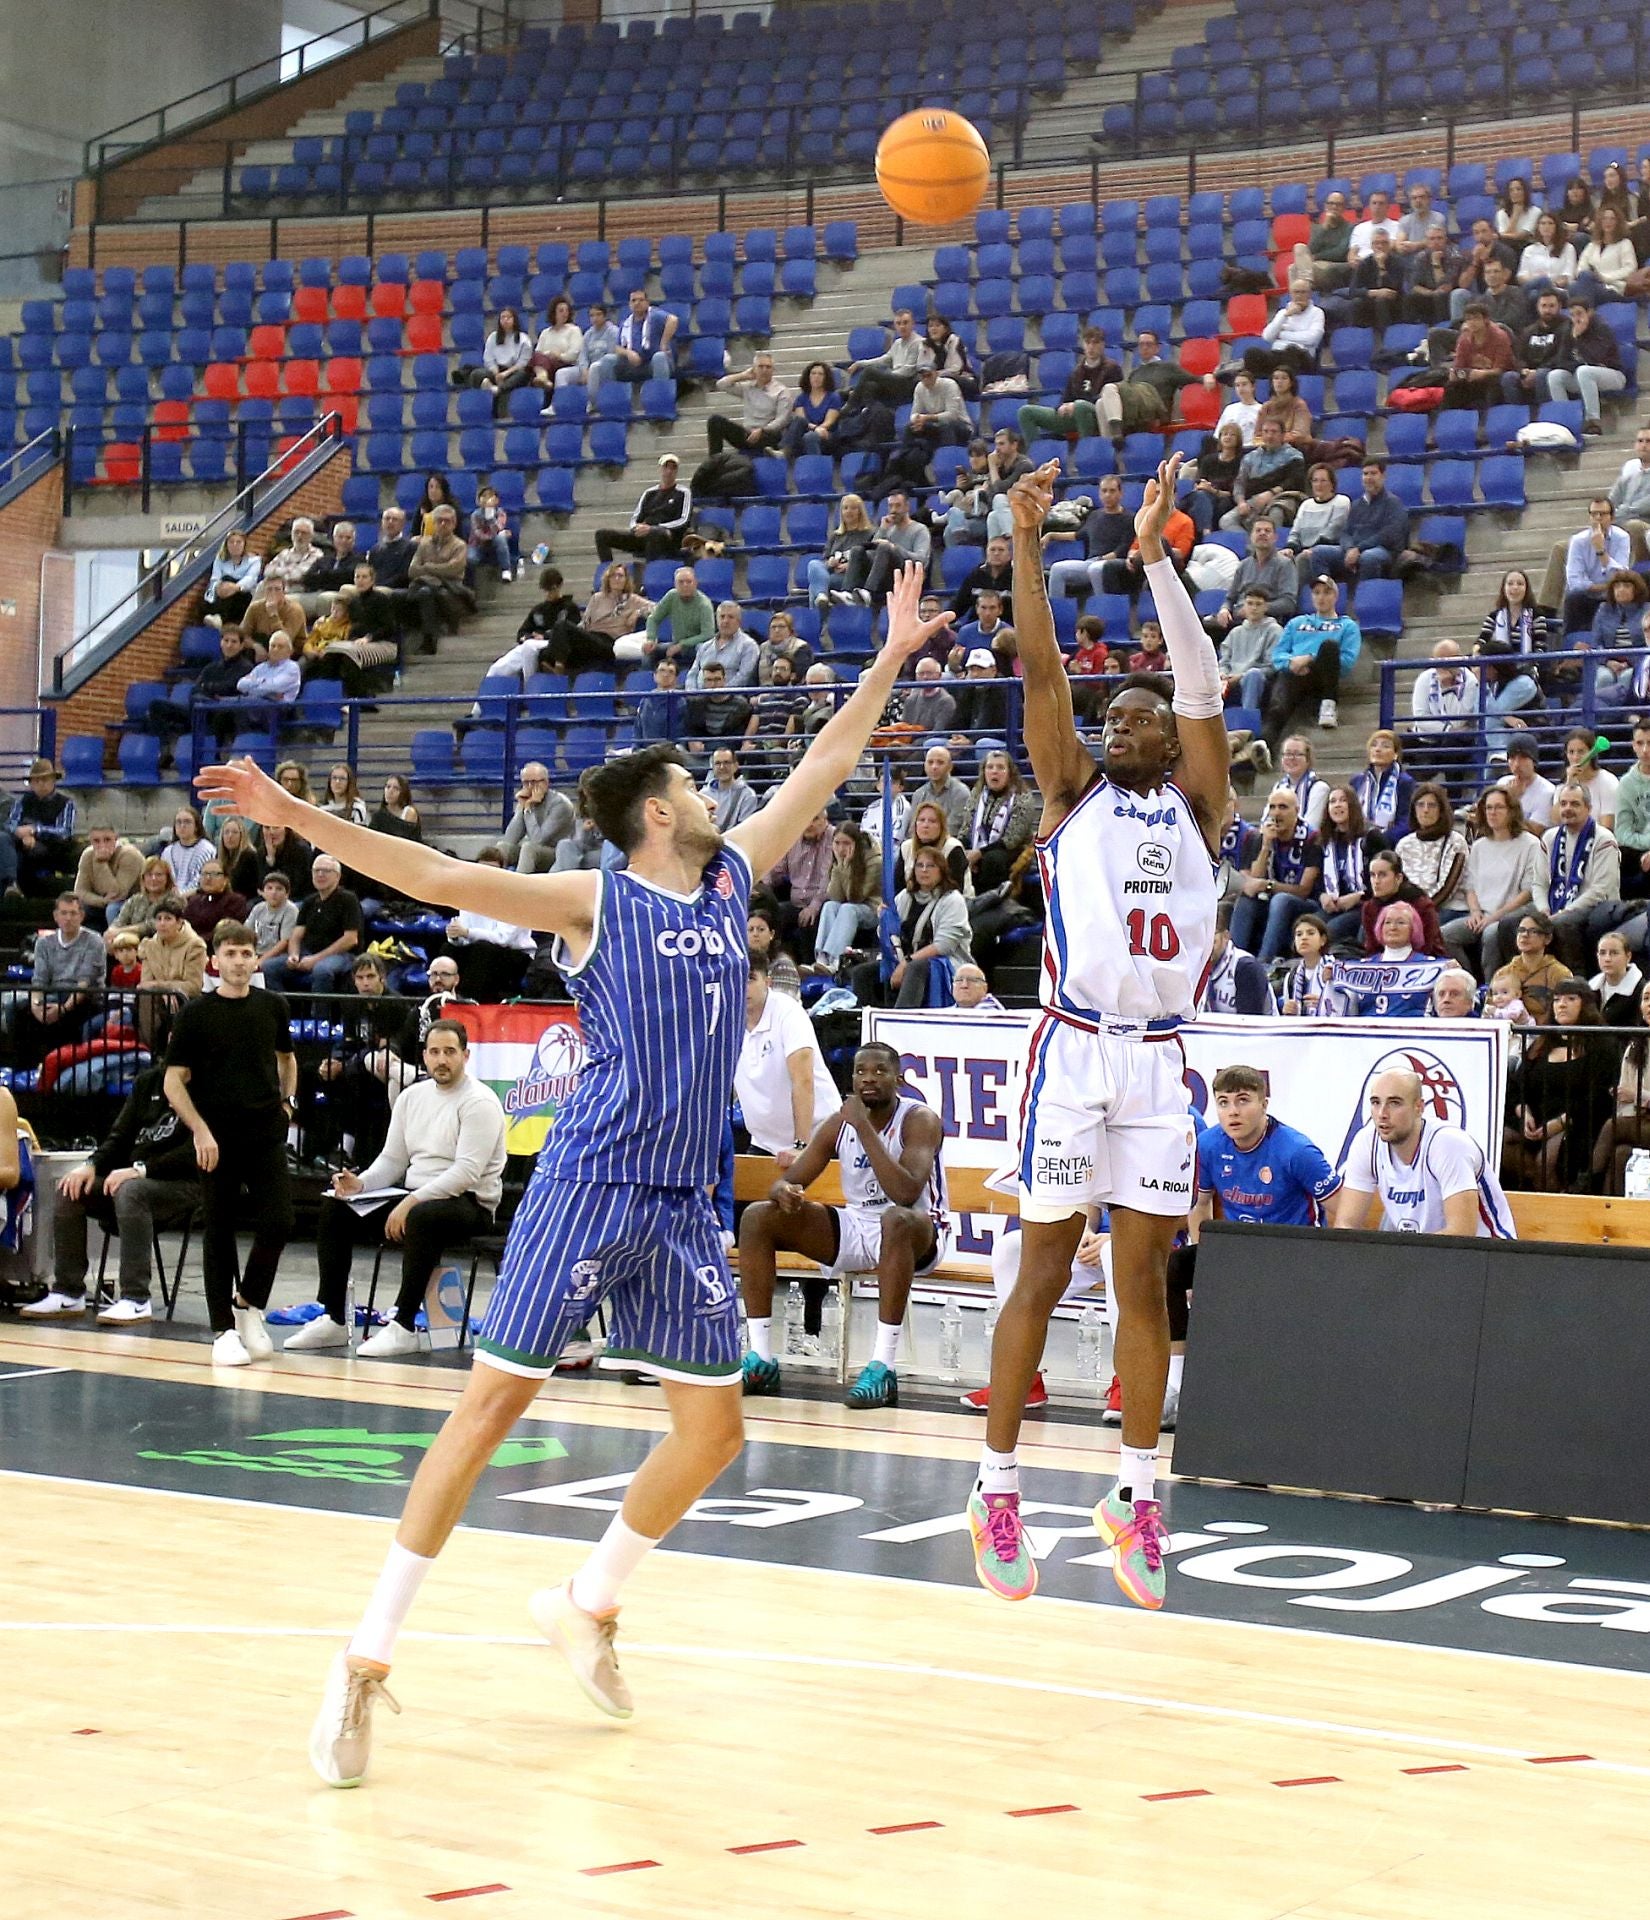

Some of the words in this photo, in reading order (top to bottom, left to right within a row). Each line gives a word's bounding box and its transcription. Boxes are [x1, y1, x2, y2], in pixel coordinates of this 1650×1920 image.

[165, 522, 200, 532] SALIDA
[1127, 908, 1180, 961] 10
[705, 982, 721, 1036] 7
[1375, 995, 1389, 1014] 9
[899, 1052, 1019, 1142] SIE
[1037, 1155, 1094, 1170] DENTAL
[1036, 1171, 1083, 1185] CHILE
[1141, 1177, 1159, 1190] LA
[1163, 1181, 1189, 1193] RIOJA
[497, 1471, 866, 1529] La
